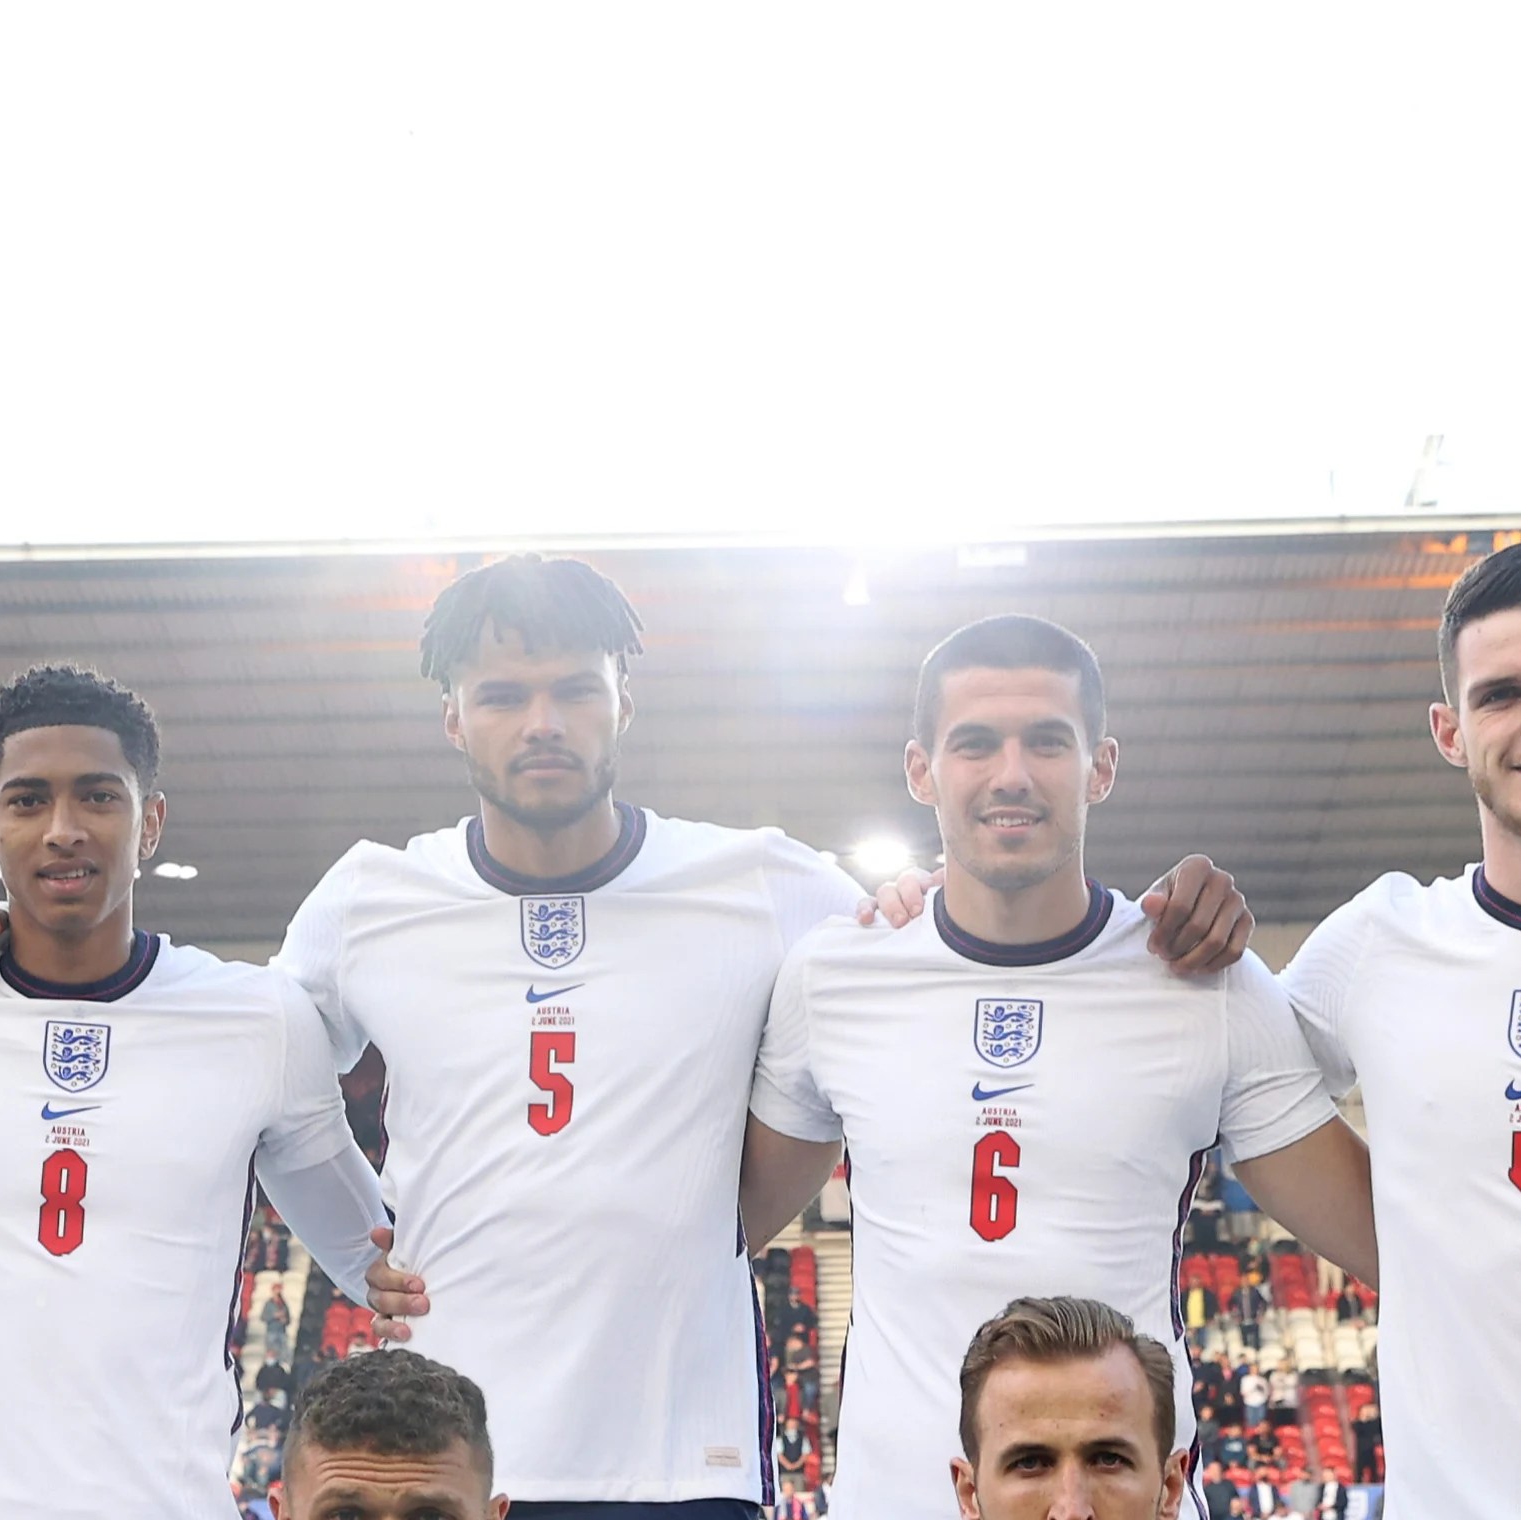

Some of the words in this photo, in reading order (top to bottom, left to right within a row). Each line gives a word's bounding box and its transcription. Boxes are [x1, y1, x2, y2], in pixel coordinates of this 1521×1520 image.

[536, 1006, 570, 1015] AUSTRIA
[537, 1016, 557, 1026] JUNE
[527, 1031, 576, 1136] 5
[981, 1107, 1017, 1116] AUSTRIA
[983, 1117, 1003, 1127] JUNE
[1005, 1118, 1022, 1128] 2021
[51, 1126, 86, 1136] AUSTRIA
[51, 1136, 71, 1145] JUNE
[970, 1130, 1021, 1242] 6
[37, 1148, 88, 1257] 8
